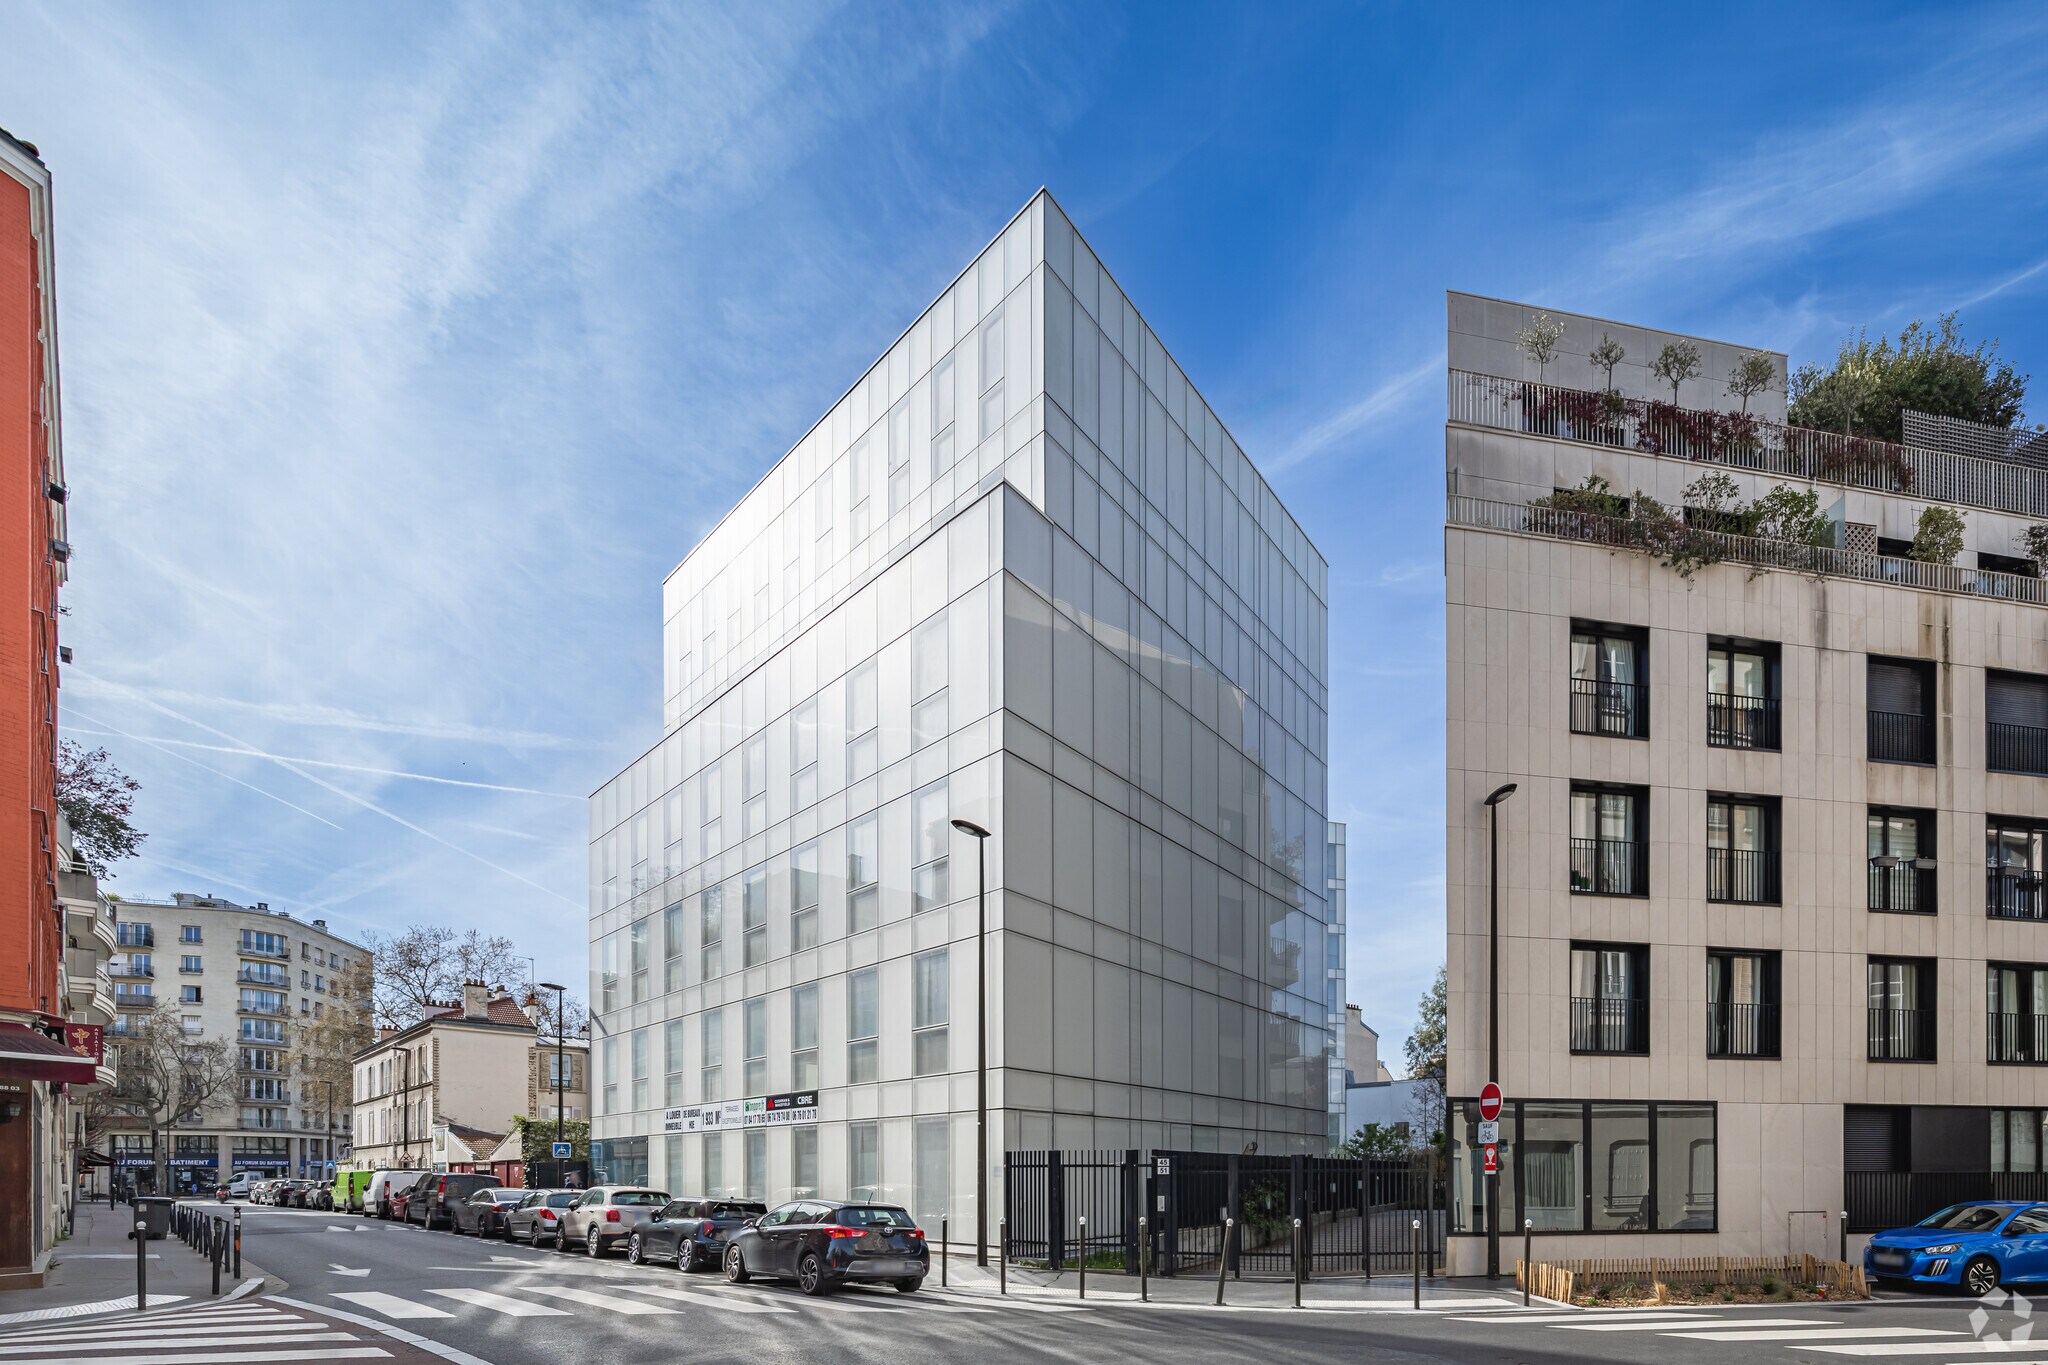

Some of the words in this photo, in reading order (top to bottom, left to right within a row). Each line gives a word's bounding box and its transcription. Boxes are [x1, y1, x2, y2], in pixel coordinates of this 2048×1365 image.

[798, 1096, 812, 1104] CBRE
[669, 1110, 681, 1119] LOUER
[688, 1109, 700, 1117] BUREAUX
